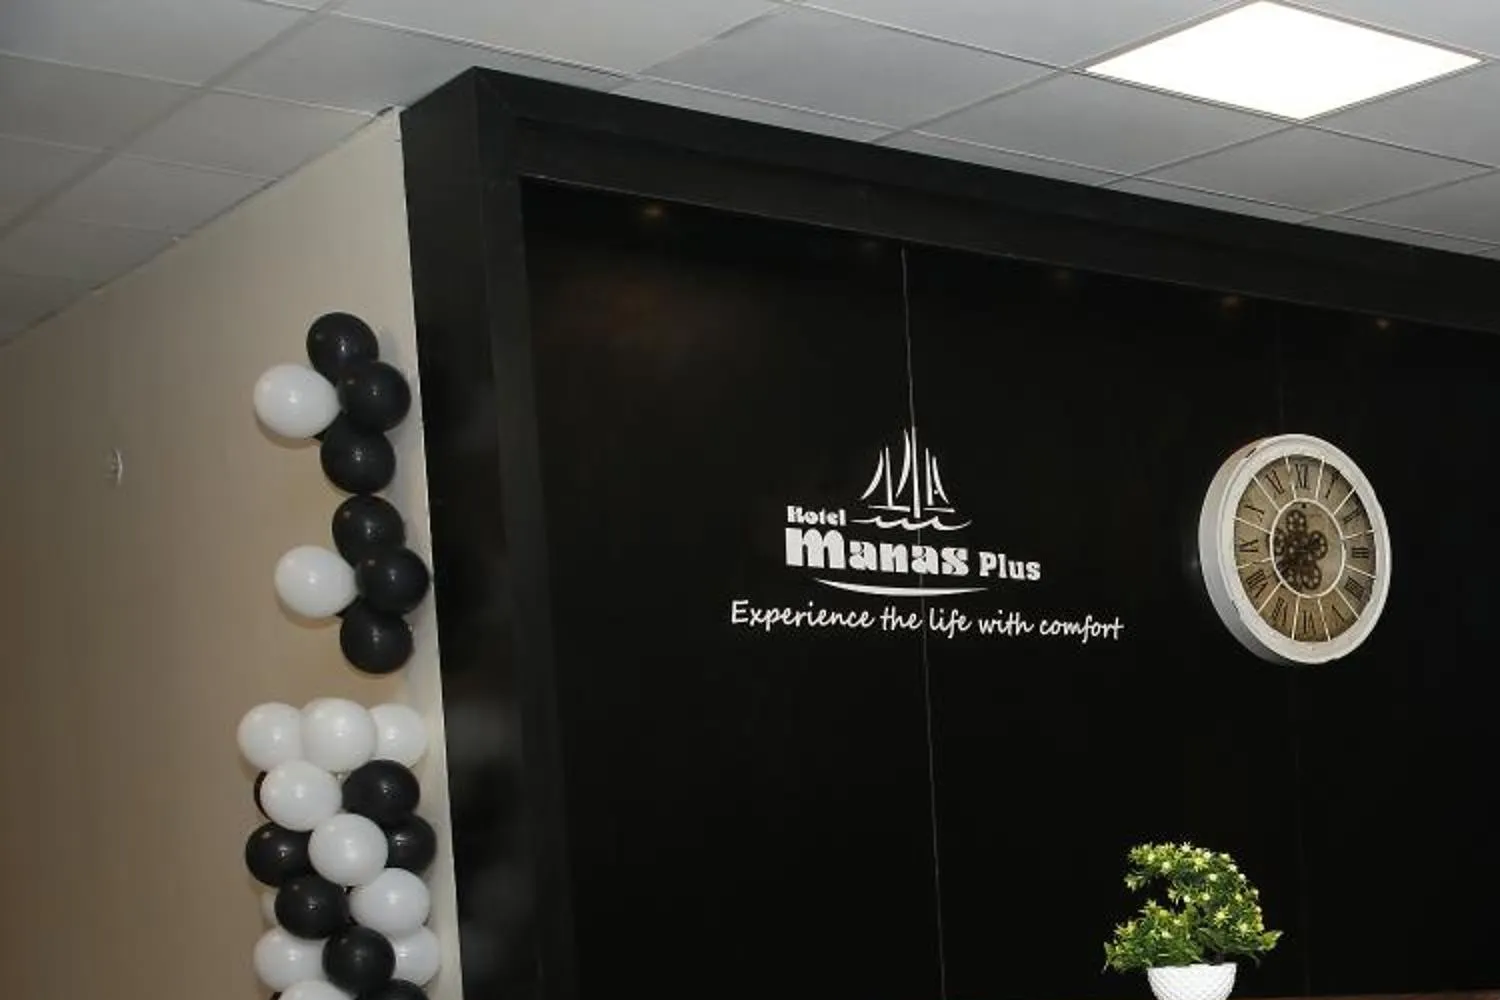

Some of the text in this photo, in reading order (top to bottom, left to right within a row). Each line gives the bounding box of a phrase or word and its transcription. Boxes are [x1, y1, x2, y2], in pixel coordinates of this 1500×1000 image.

[786, 505, 847, 527] Hotel
[979, 551, 1041, 581] Plus
[731, 600, 1125, 644] Experience the life with comfort
